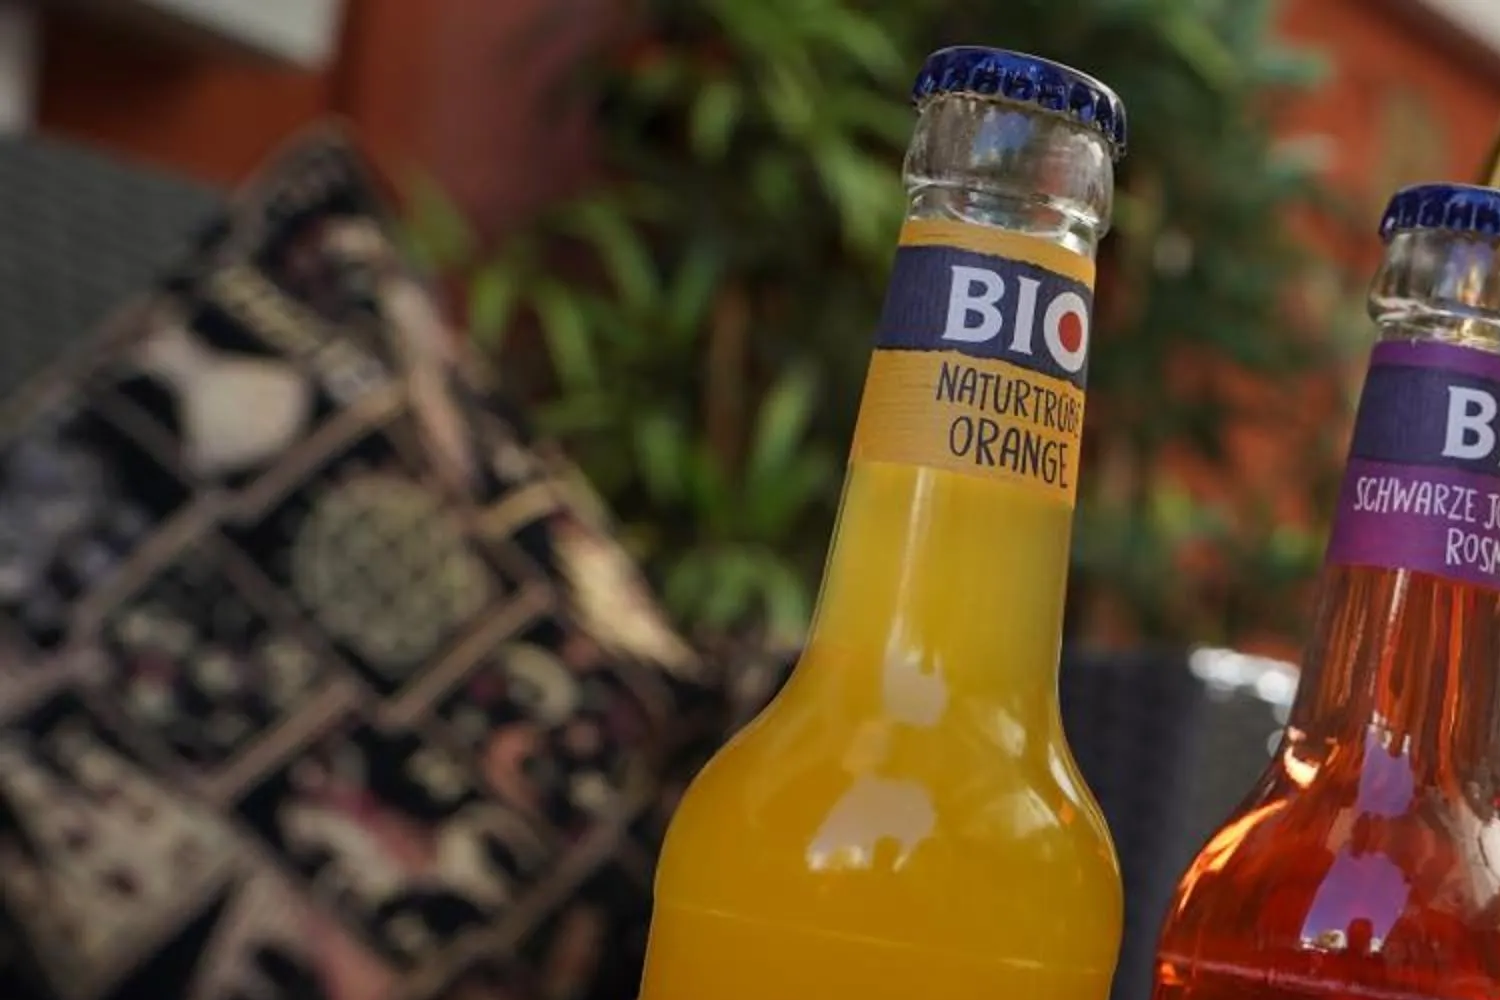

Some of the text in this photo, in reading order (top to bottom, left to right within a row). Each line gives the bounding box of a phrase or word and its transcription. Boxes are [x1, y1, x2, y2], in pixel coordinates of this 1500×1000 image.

[941, 265, 1089, 373] BIO
[949, 416, 1068, 488] ORANGE
[1353, 476, 1479, 522] SCHWARZE
